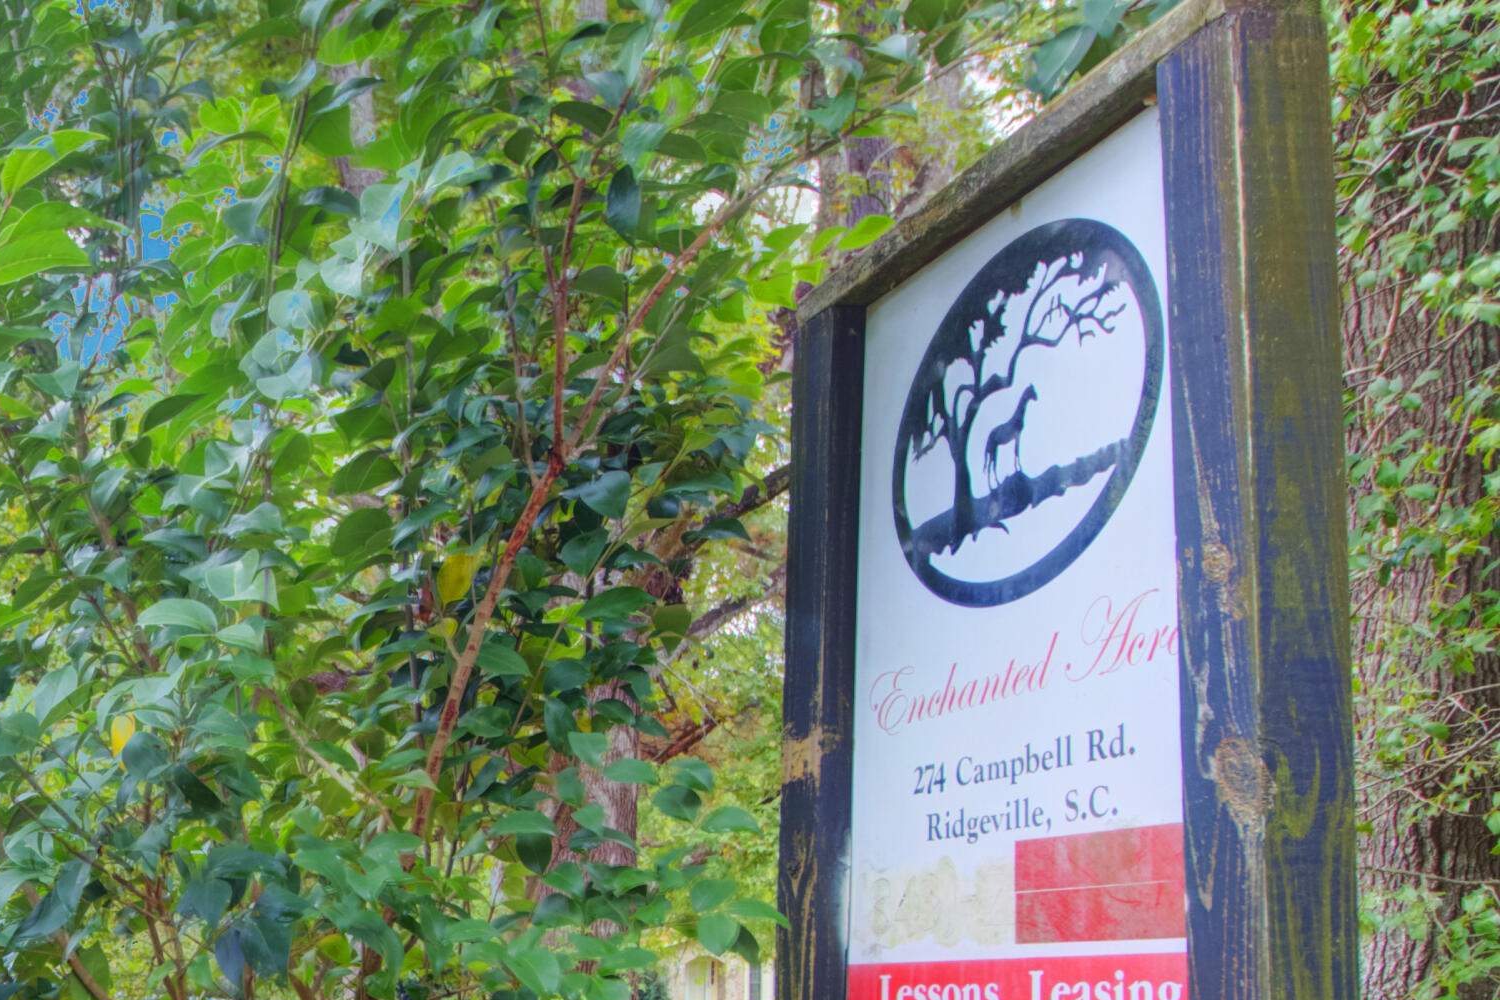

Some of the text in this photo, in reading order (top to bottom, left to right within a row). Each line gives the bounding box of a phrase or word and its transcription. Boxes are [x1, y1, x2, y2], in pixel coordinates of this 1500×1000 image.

[869, 632, 1059, 735] Enchanted
[913, 723, 1135, 795] 274 Campbell Rd.
[926, 785, 1118, 845] Ridgeville, S.C.
